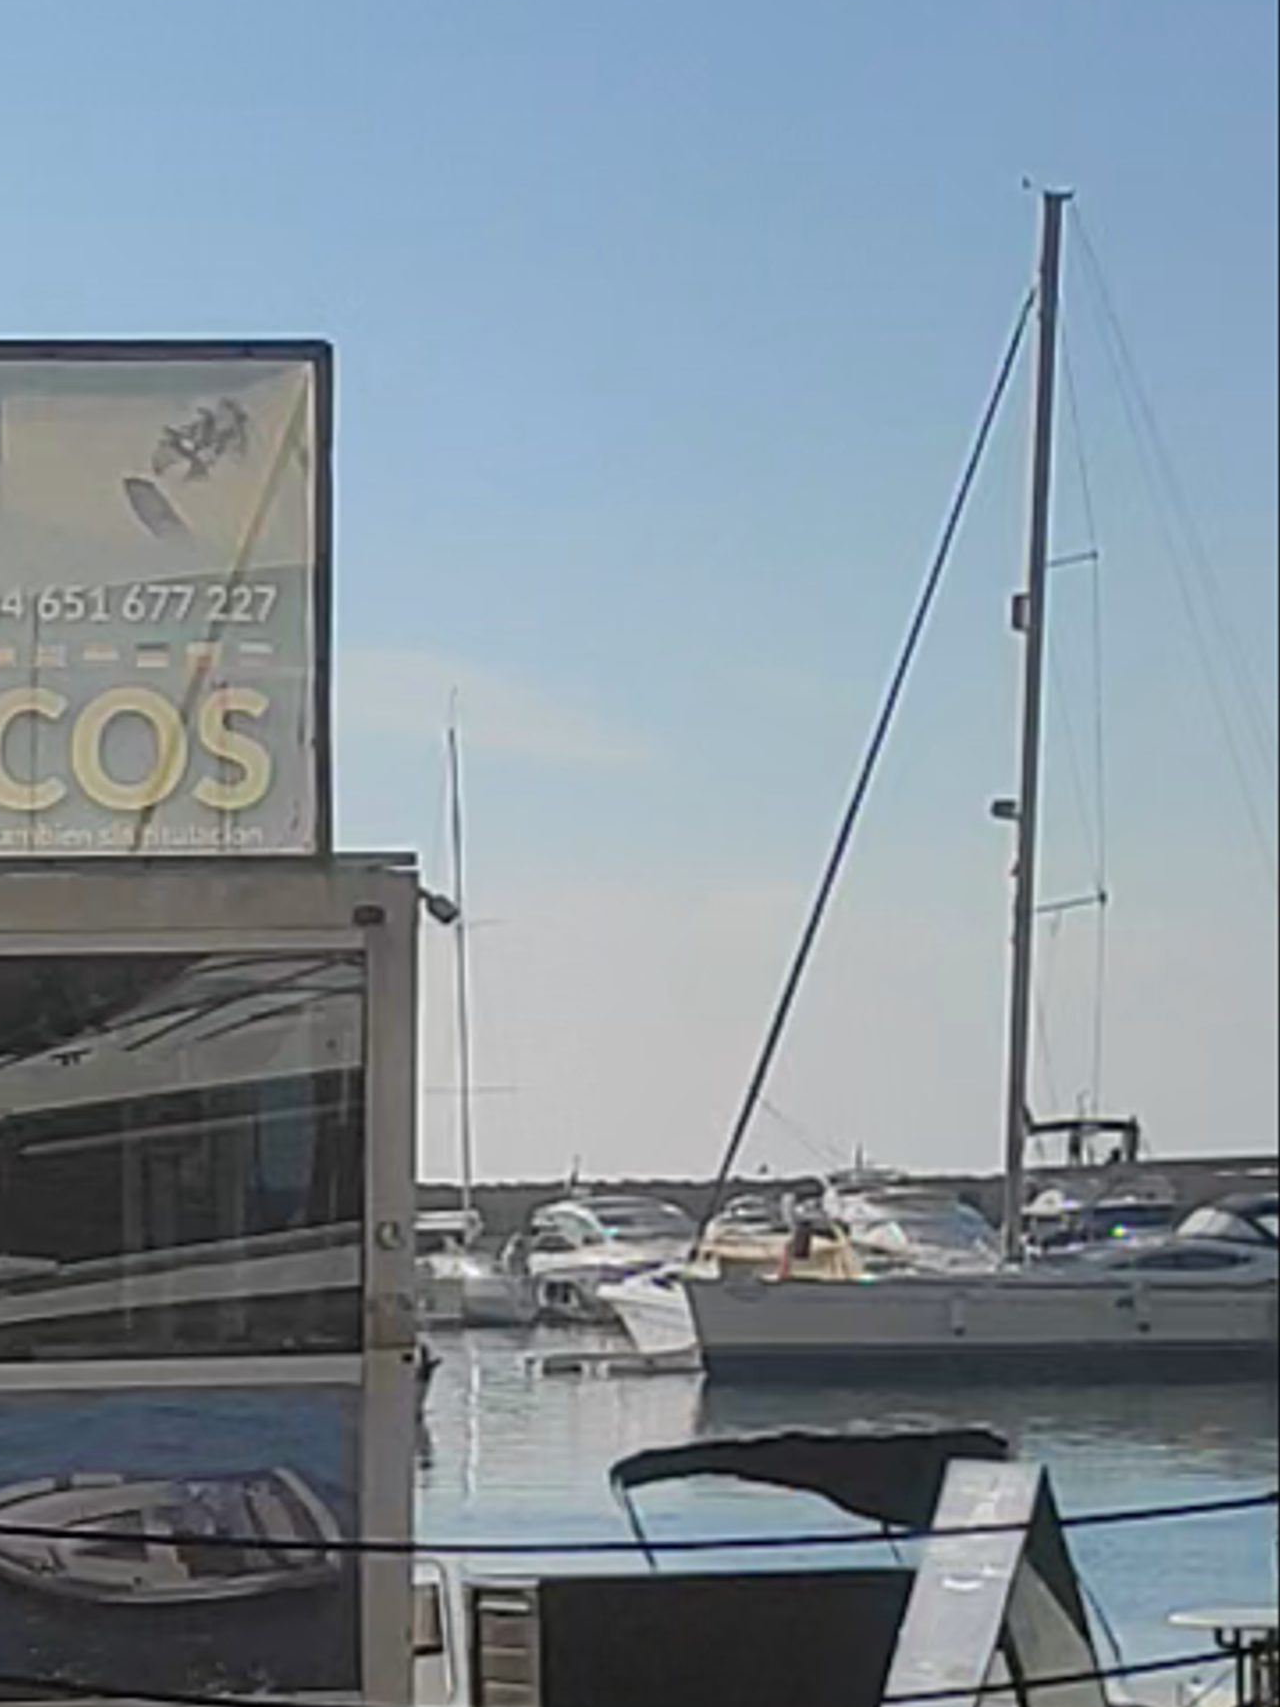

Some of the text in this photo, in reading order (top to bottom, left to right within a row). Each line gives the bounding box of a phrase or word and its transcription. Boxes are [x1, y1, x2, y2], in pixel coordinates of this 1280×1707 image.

[37, 584, 110, 622] 651
[121, 584, 195, 622] 677
[205, 584, 278, 623] 227
